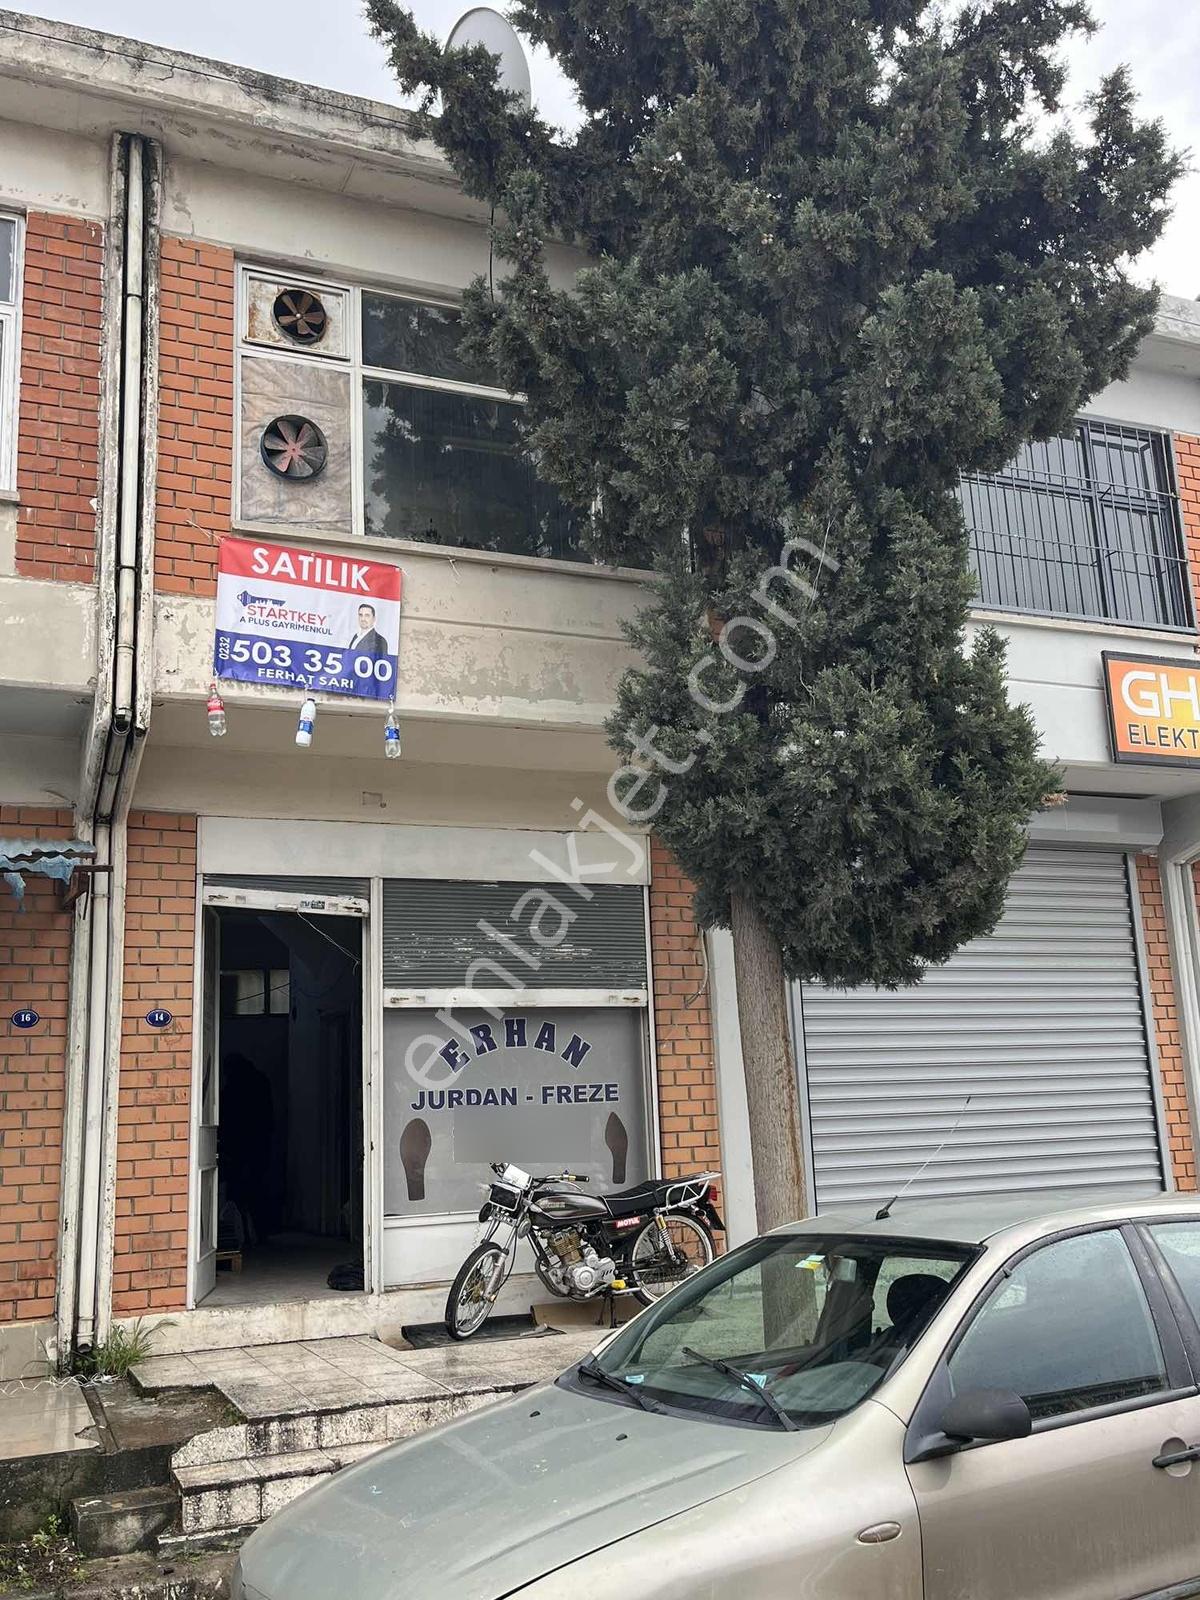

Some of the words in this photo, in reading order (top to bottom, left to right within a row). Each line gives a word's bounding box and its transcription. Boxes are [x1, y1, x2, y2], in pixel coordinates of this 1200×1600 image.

[247, 604, 327, 626] STARTKEY
[248, 616, 270, 627] PLUS
[271, 619, 333, 636] GAYRİMENKUL
[218, 636, 231, 660] 0232
[230, 639, 292, 667] 503
[303, 649, 343, 674] 35
[354, 656, 392, 681] 00
[257, 667, 315, 684] FERHAT
[319, 676, 354, 689] SARI
[1121, 670, 1200, 721] GH
[1128, 723, 1199, 749] ELEKT
[21, 1013, 31, 1022] 16
[155, 1012, 164, 1021] 14
[438, 1017, 592, 1074] ERHAN
[411, 1086, 518, 1111] JURDAN
[541, 1083, 619, 1104] FREZE
[616, 1216, 640, 1228] MOTUL
